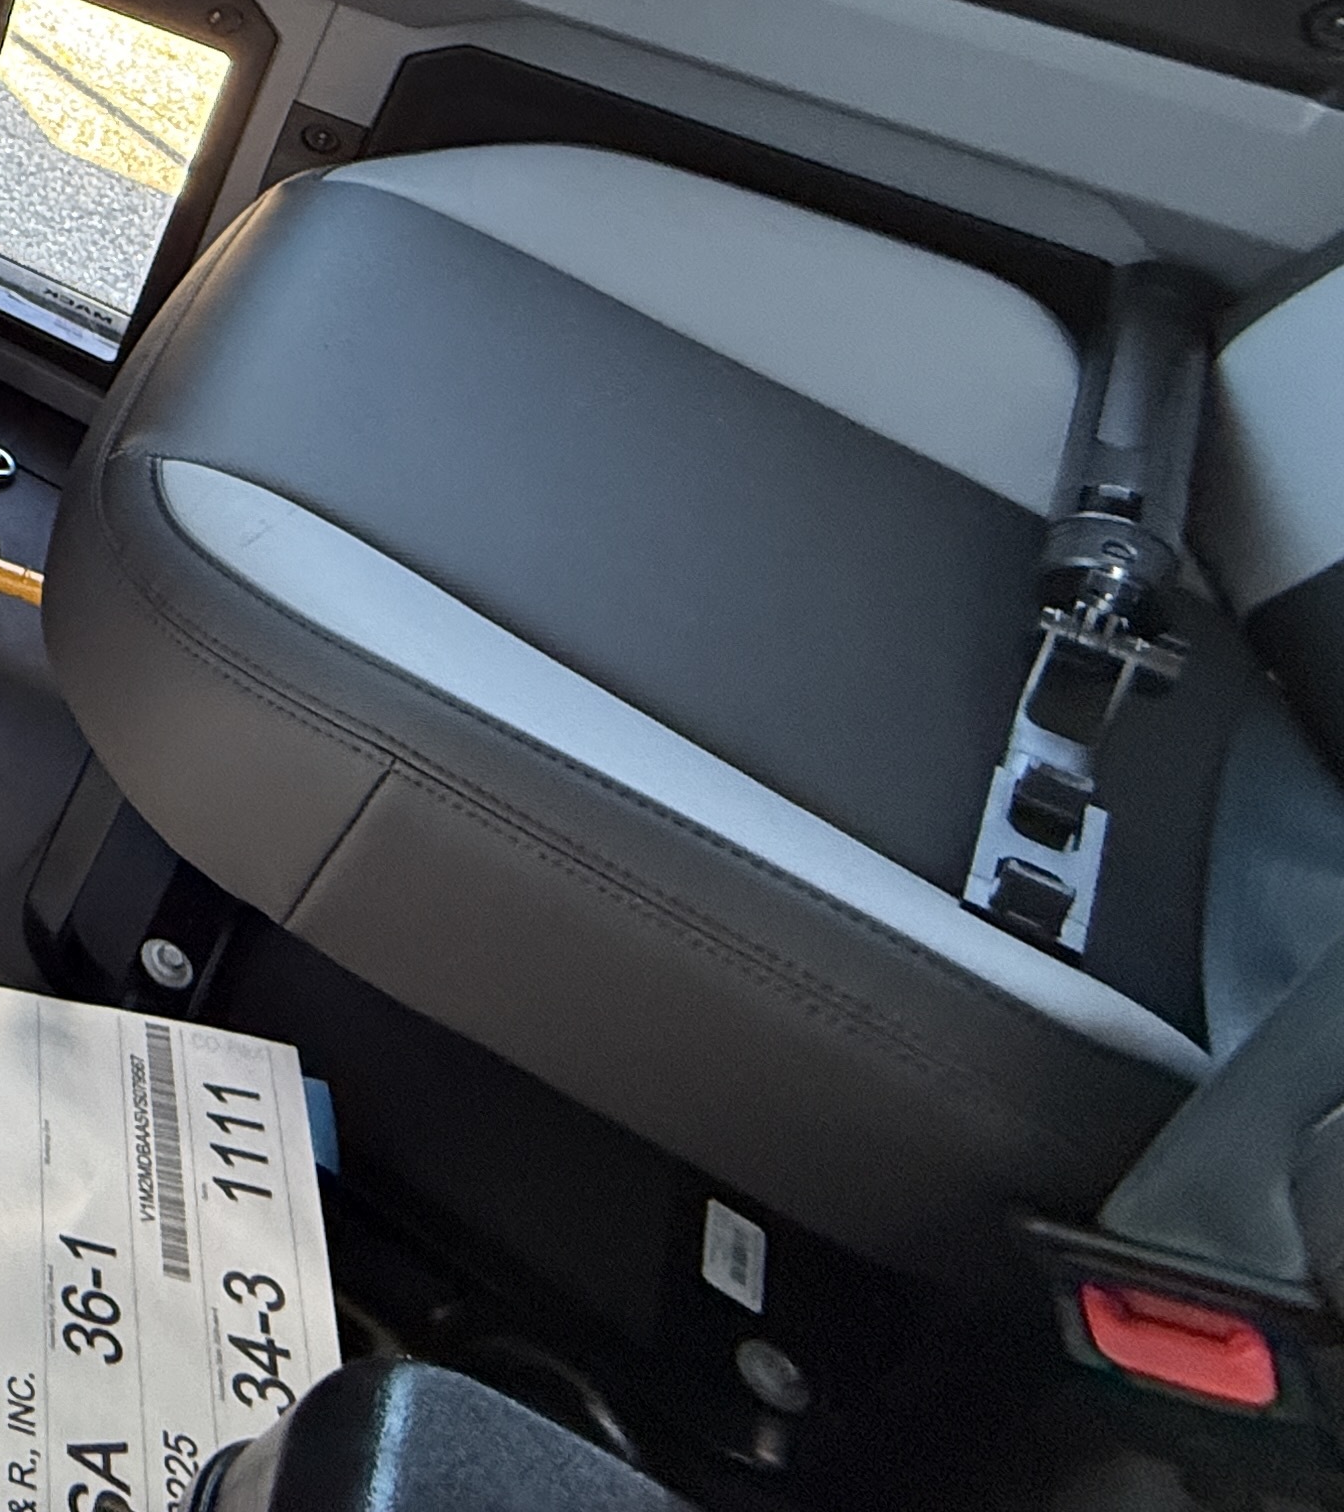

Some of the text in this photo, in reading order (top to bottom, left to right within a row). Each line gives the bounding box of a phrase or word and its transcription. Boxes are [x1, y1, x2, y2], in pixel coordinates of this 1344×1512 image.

[202, 1081, 273, 1203] 1111
[58, 1232, 124, 1366] 36-1
[222, 1269, 298, 1418] 34-3
[6, 1372, 37, 1437] INC.
